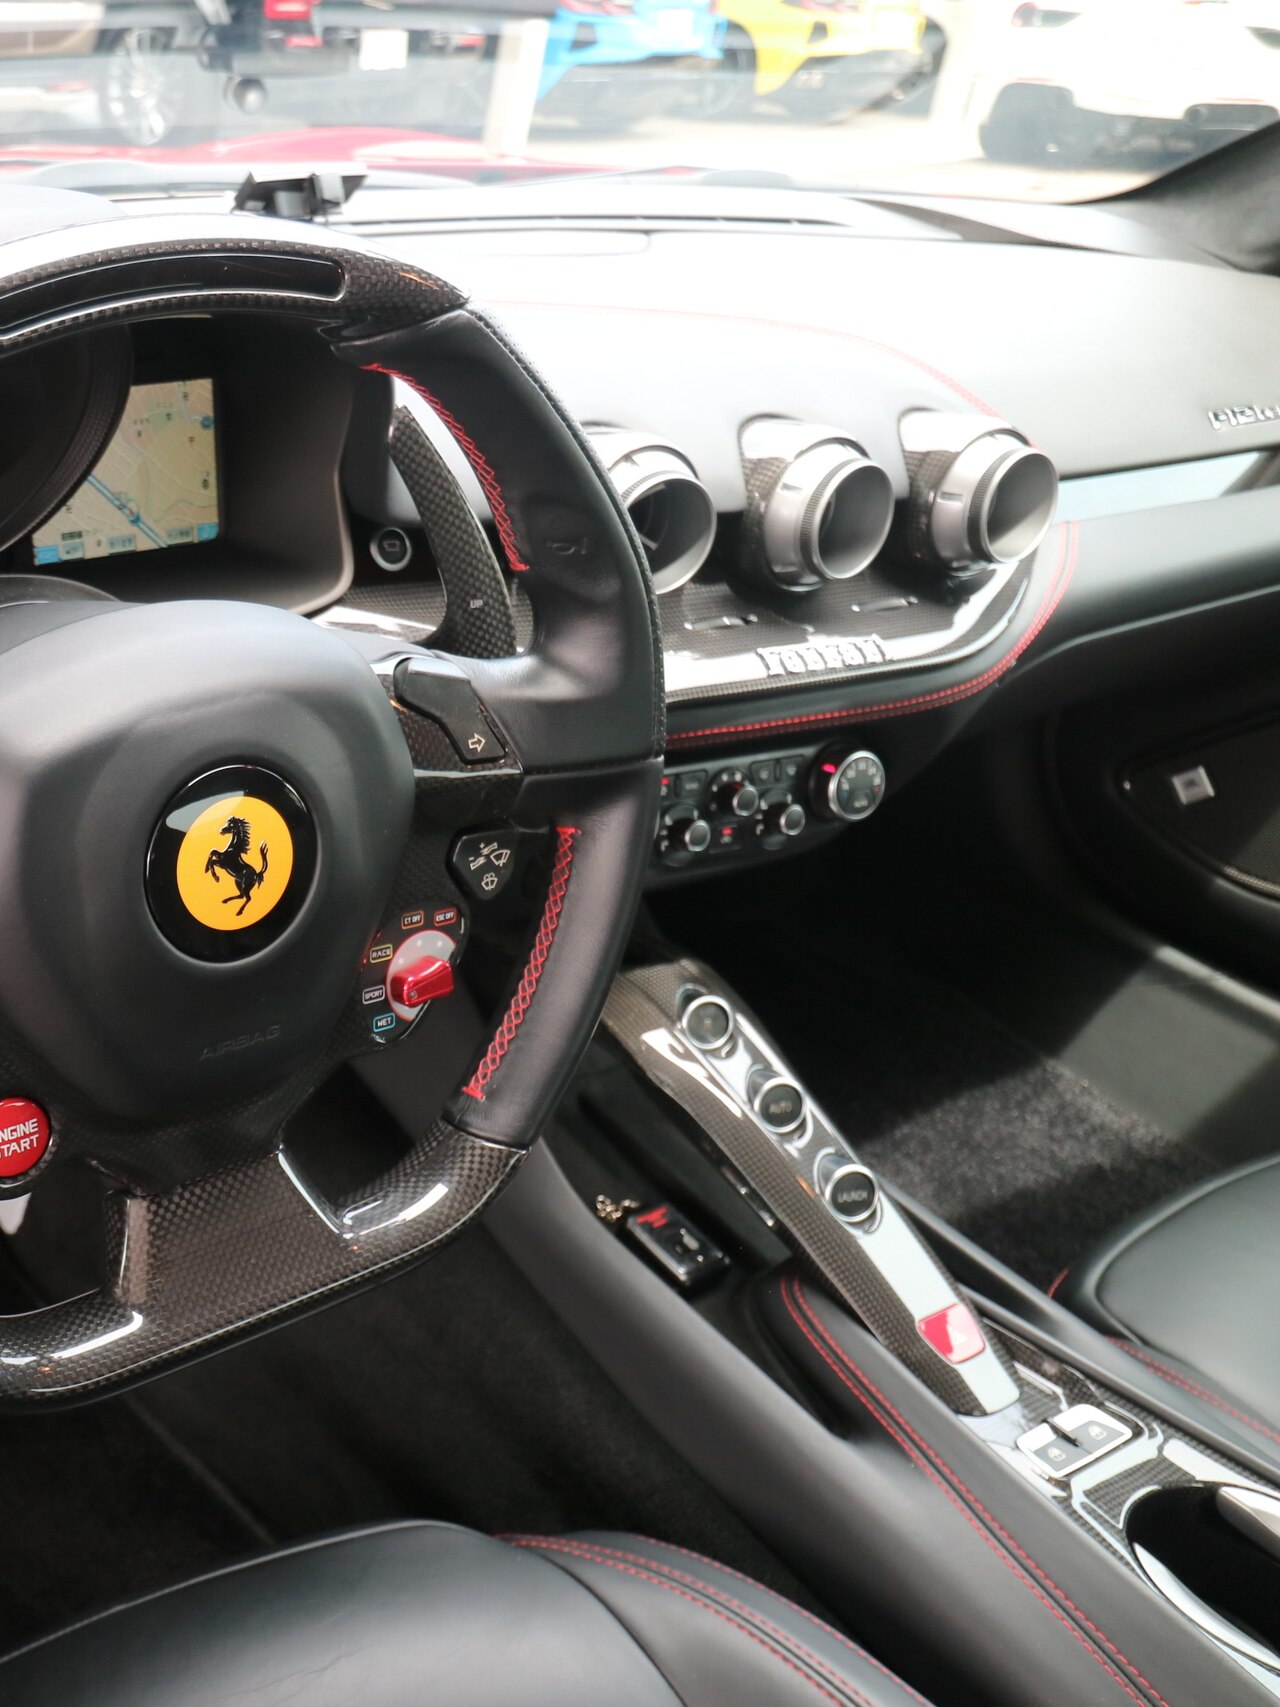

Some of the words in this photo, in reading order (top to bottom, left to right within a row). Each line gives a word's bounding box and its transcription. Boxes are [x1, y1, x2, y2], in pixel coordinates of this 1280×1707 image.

[470, 599, 484, 609] UP
[372, 949, 392, 959] RACE
[364, 989, 383, 1000] SPORT
[377, 1017, 392, 1027] WET
[199, 1024, 281, 1061] AIRBAG
